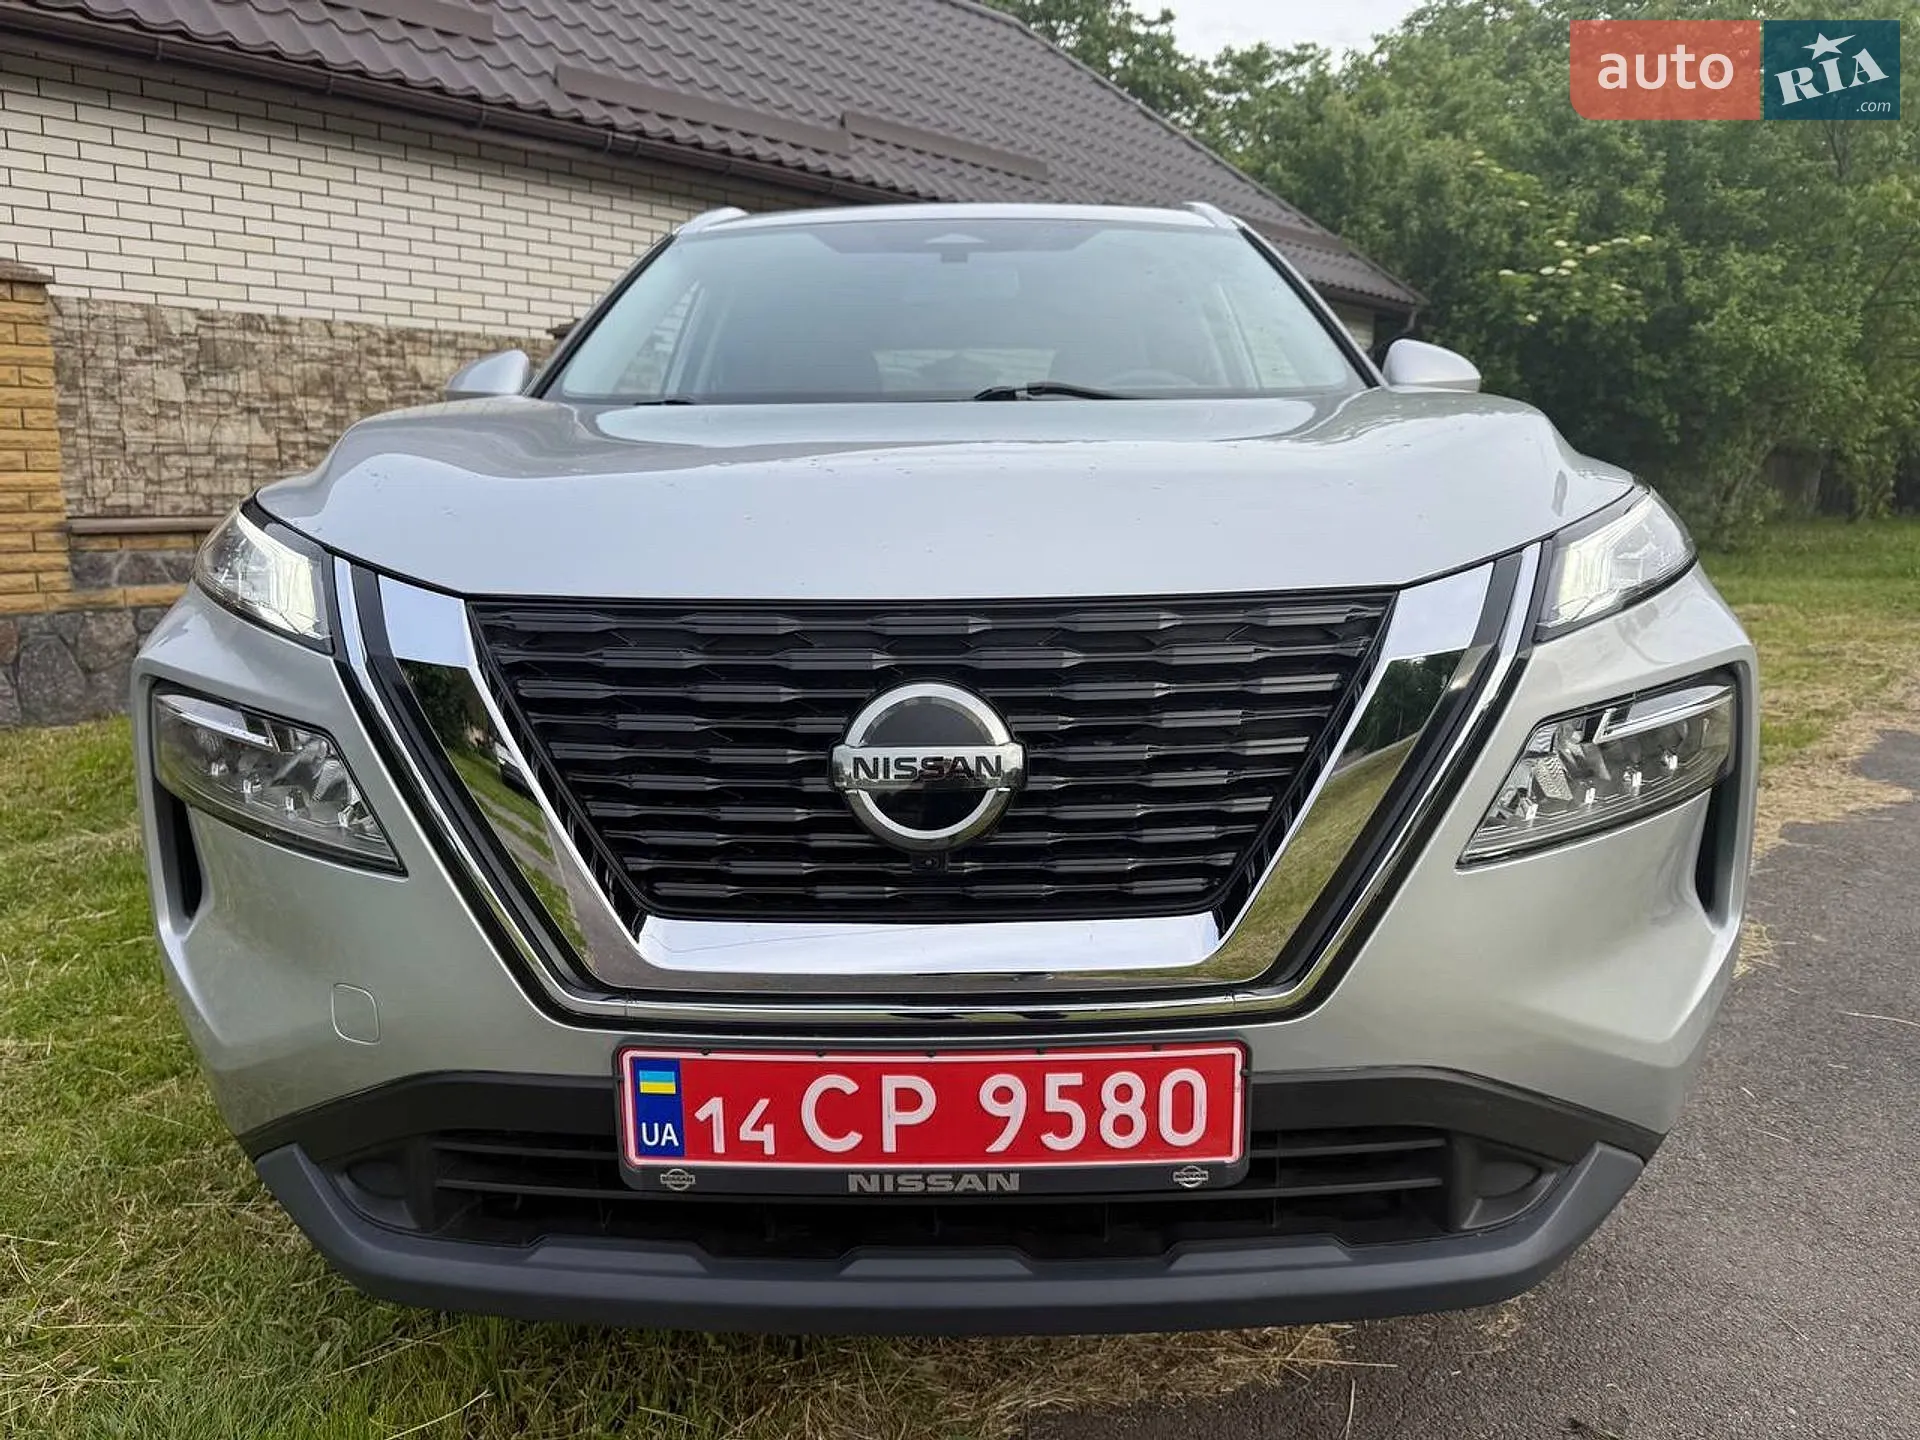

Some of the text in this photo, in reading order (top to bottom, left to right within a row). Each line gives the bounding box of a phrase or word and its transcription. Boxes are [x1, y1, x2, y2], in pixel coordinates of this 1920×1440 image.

[853, 755, 1002, 780] NISSAN
[694, 1068, 1208, 1155] 14 CP 9580
[641, 1122, 680, 1147] UA
[847, 1172, 1020, 1194] NISSAN
